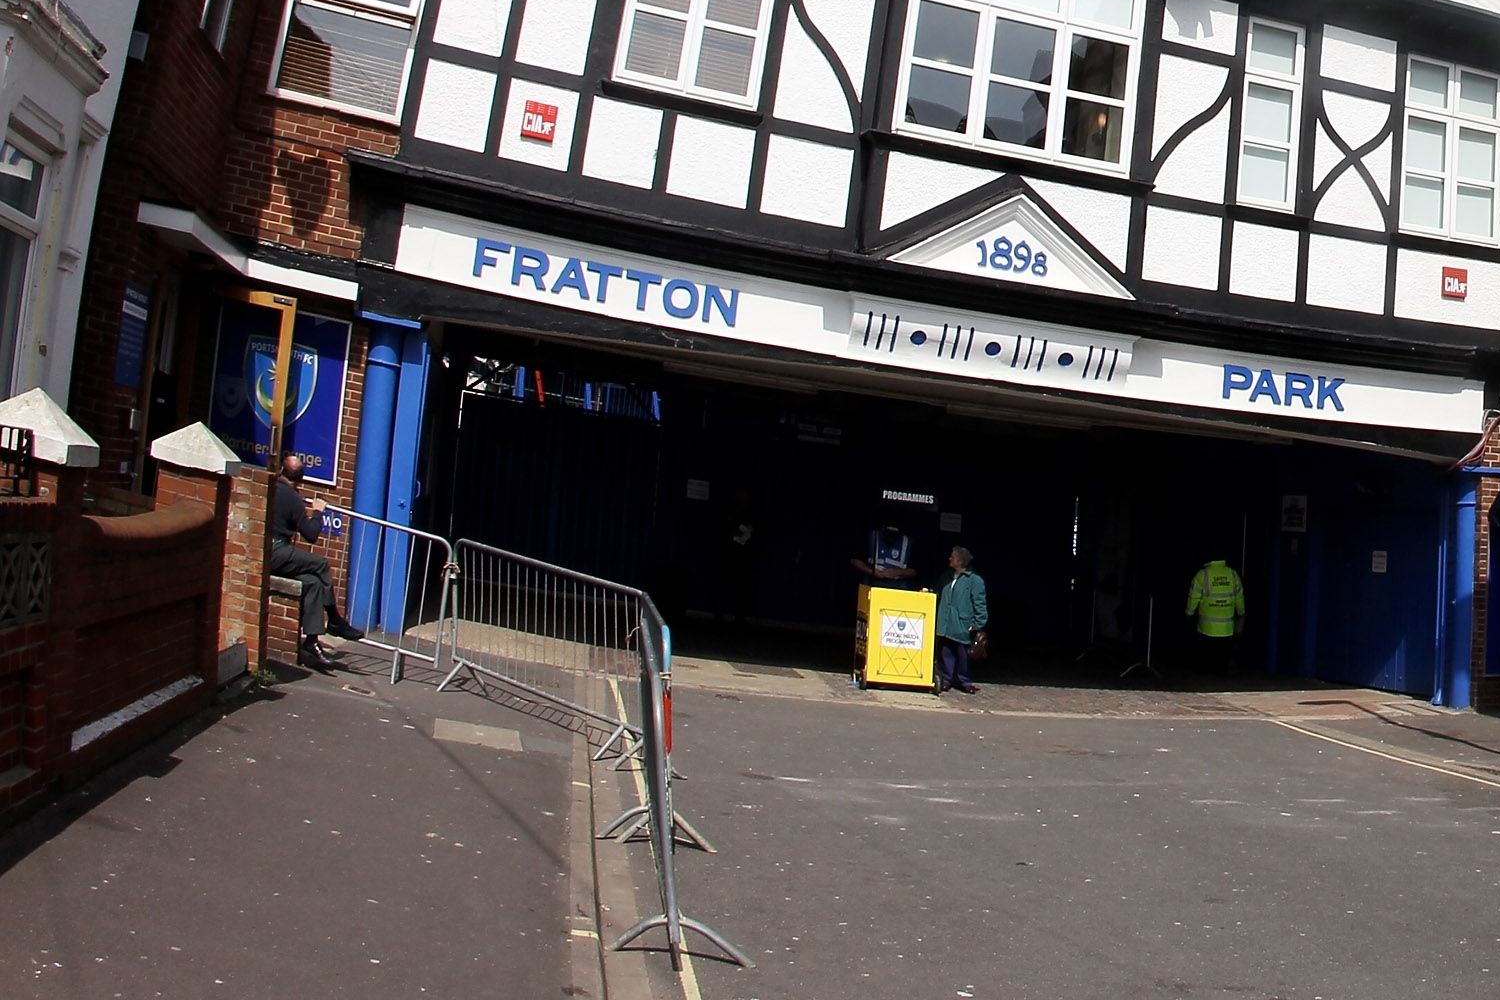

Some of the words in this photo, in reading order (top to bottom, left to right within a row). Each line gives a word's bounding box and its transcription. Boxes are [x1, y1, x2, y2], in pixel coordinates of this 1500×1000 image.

[522, 112, 543, 134] CIA
[976, 236, 1048, 278] 1898
[473, 237, 740, 328] FRATTON
[1444, 277, 1460, 293] CIA
[1222, 364, 1345, 412] PARK
[882, 490, 935, 505] PROGRAMMES
